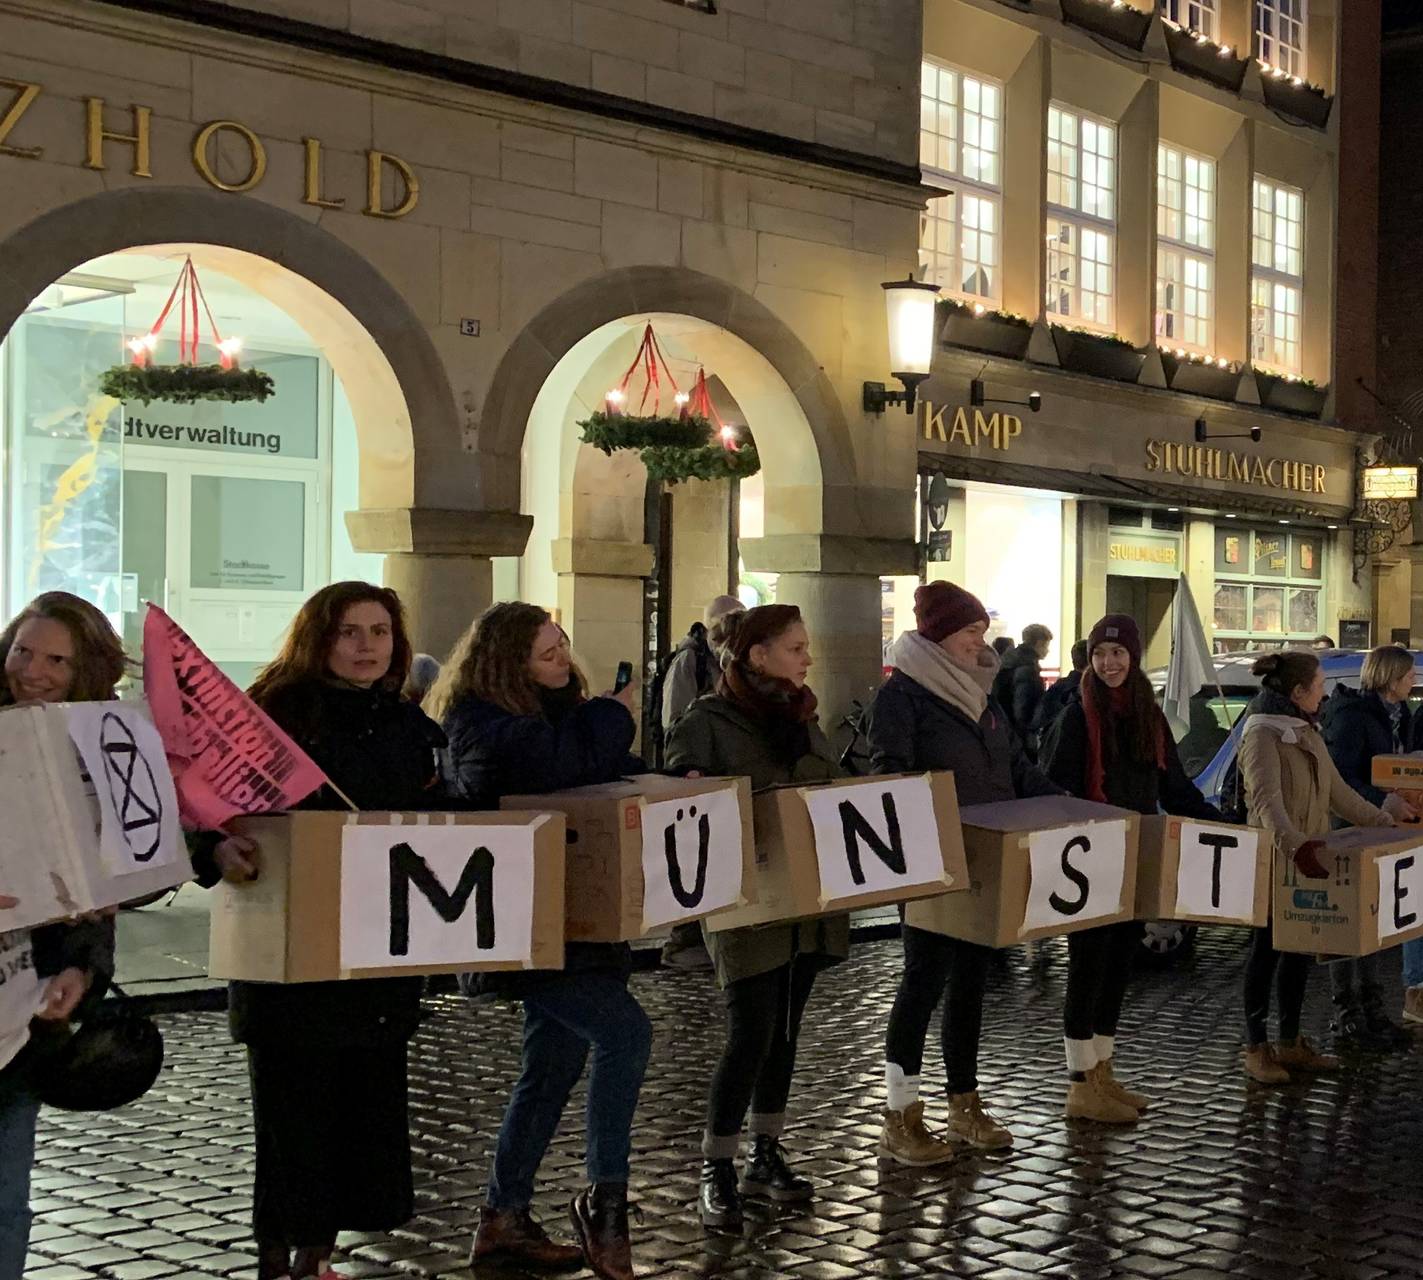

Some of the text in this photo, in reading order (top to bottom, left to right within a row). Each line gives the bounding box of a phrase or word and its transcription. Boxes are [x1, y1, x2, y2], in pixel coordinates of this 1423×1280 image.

[467, 320, 474, 334] 5
[1145, 439, 1326, 493] STUHLMACHER
[1110, 543, 1177, 565] STUHLMACHER
[389, 842, 495, 956] M
[664, 804, 711, 908] Ü
[838, 791, 907, 886] N
[1048, 835, 1092, 916] S
[1199, 832, 1238, 909] T
[1394, 855, 1417, 929] E
